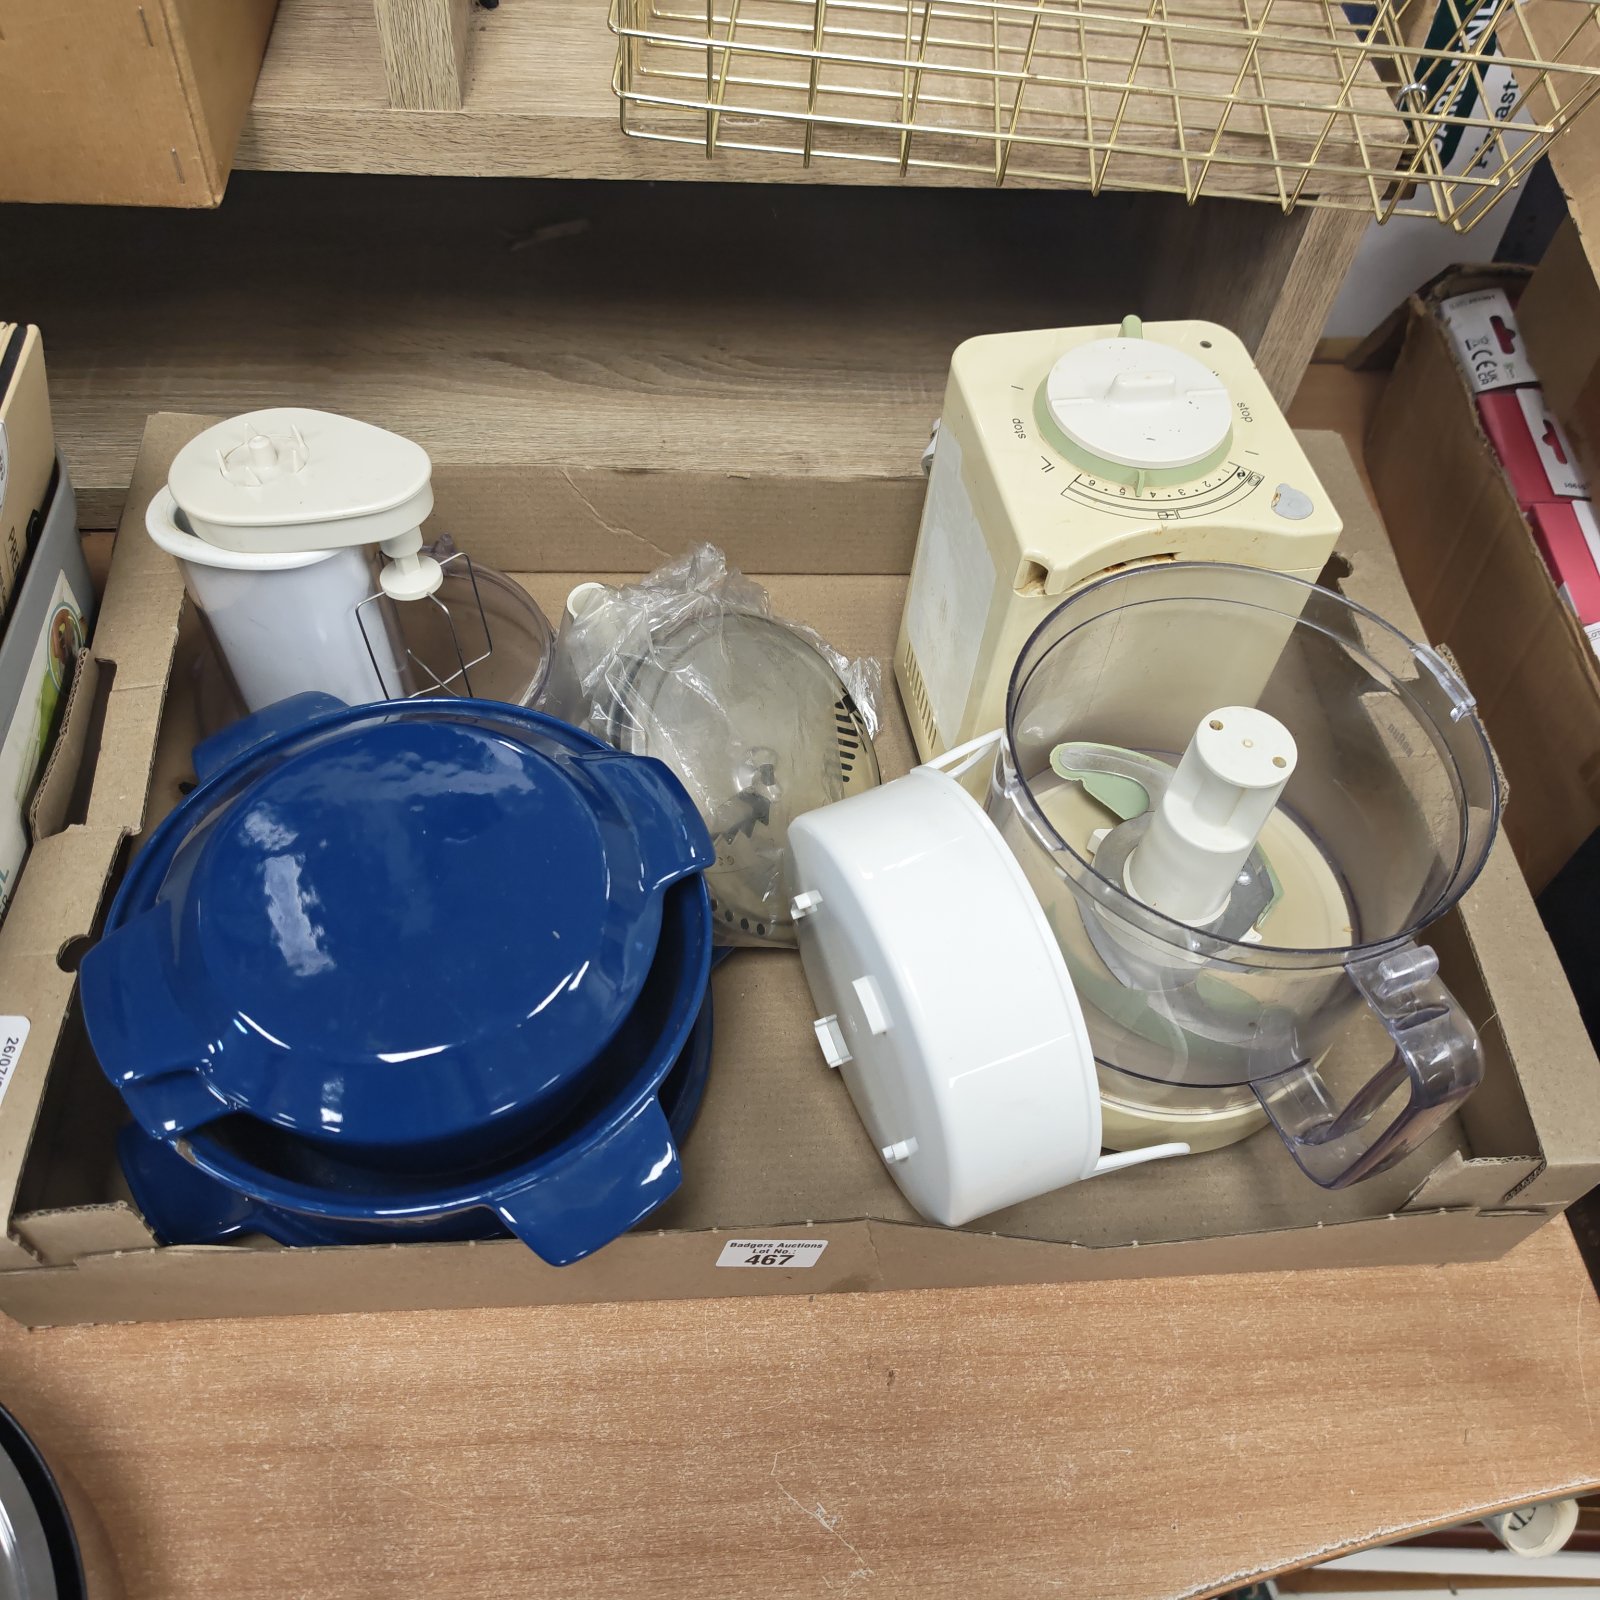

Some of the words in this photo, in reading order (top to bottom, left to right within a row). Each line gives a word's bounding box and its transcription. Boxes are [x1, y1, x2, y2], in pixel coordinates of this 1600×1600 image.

[1236, 400, 1253, 424] stop
[1011, 417, 1027, 440] stop
[1088, 479, 1096, 487] 6
[1202, 480, 1212, 488] 2
[1119, 488, 1126, 496] 5
[1149, 491, 1157, 499] 4
[1177, 488, 1186, 496] 3
[744, 1254, 795, 1266] 467
